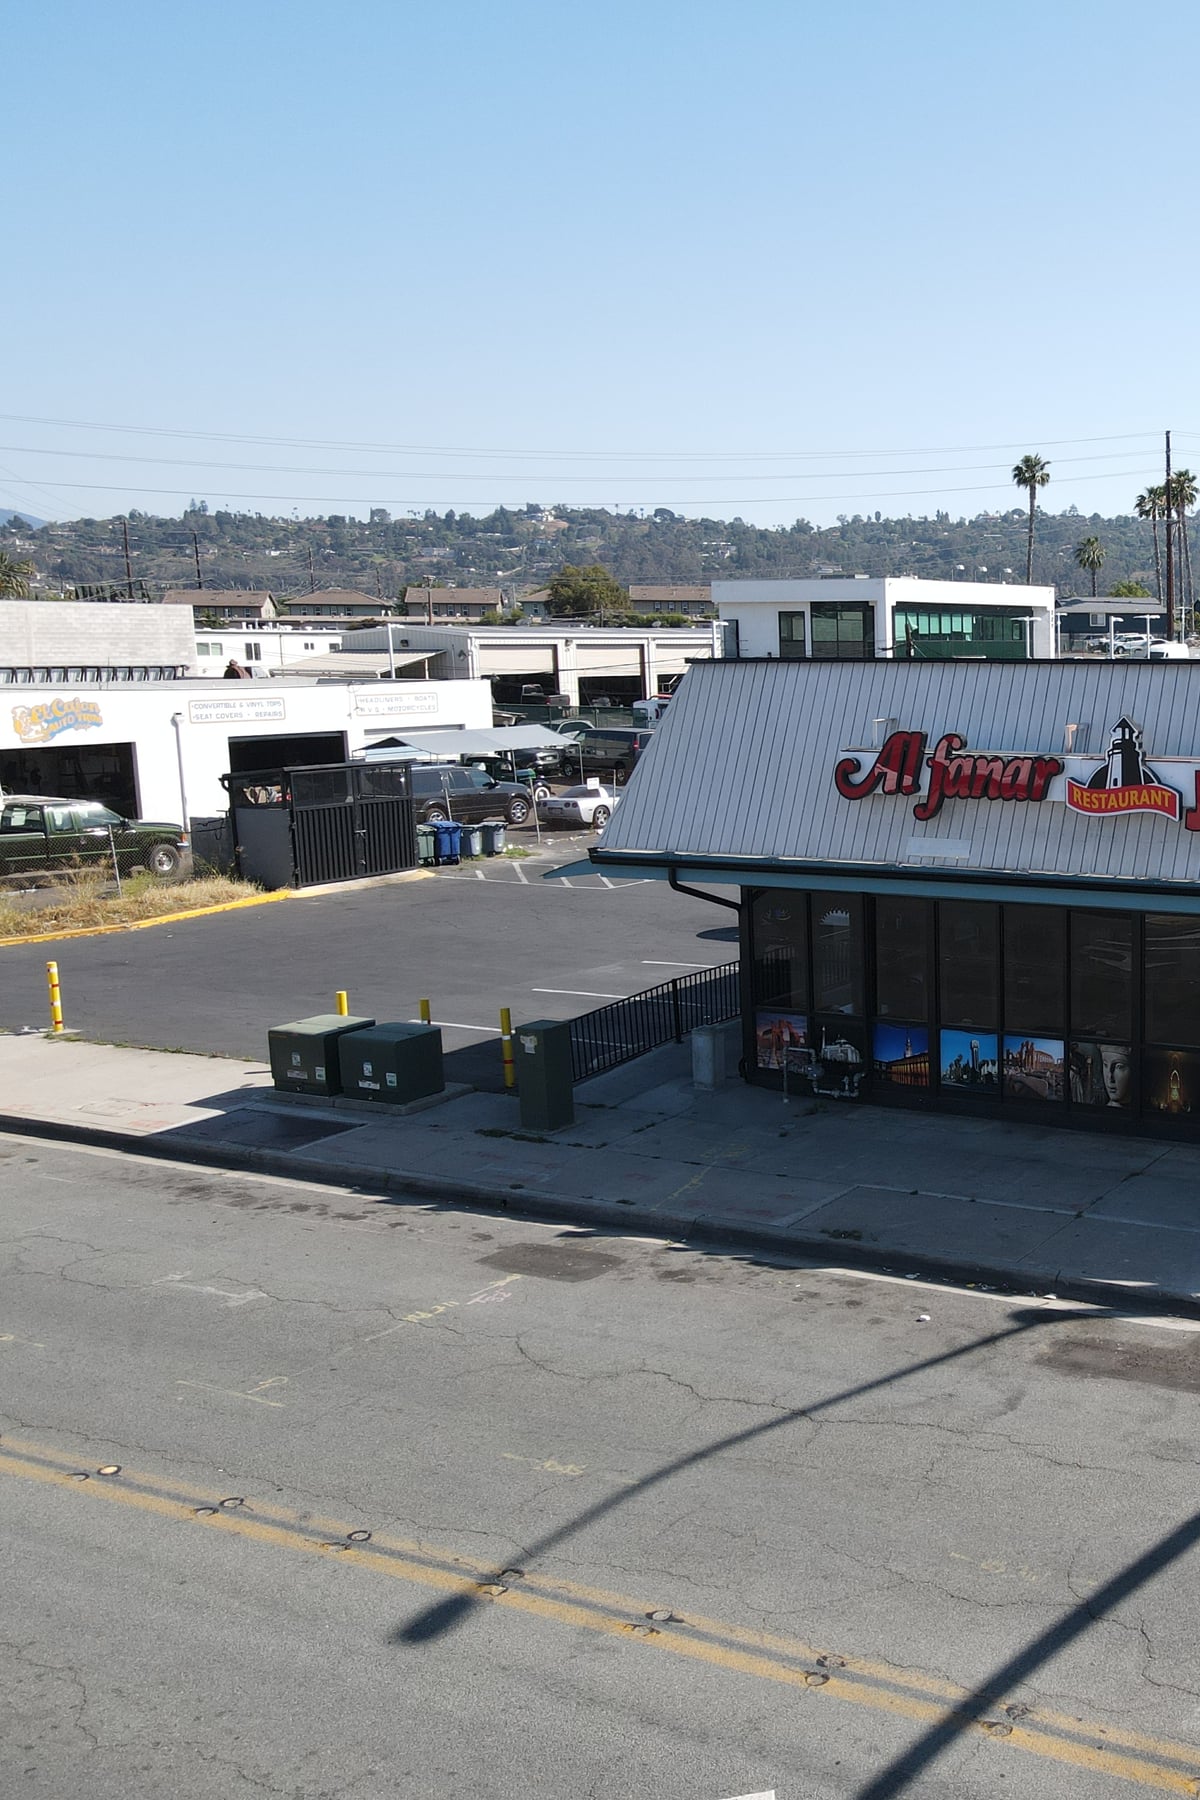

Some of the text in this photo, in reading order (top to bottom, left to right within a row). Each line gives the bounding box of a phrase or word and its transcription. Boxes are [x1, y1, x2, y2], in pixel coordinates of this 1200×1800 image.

[193, 702, 237, 710] CONVERTIBLE
[255, 710, 283, 718] REPAIRS
[835, 731, 1063, 821] Al fanar
[1072, 785, 1172, 809] RESTAURANT
